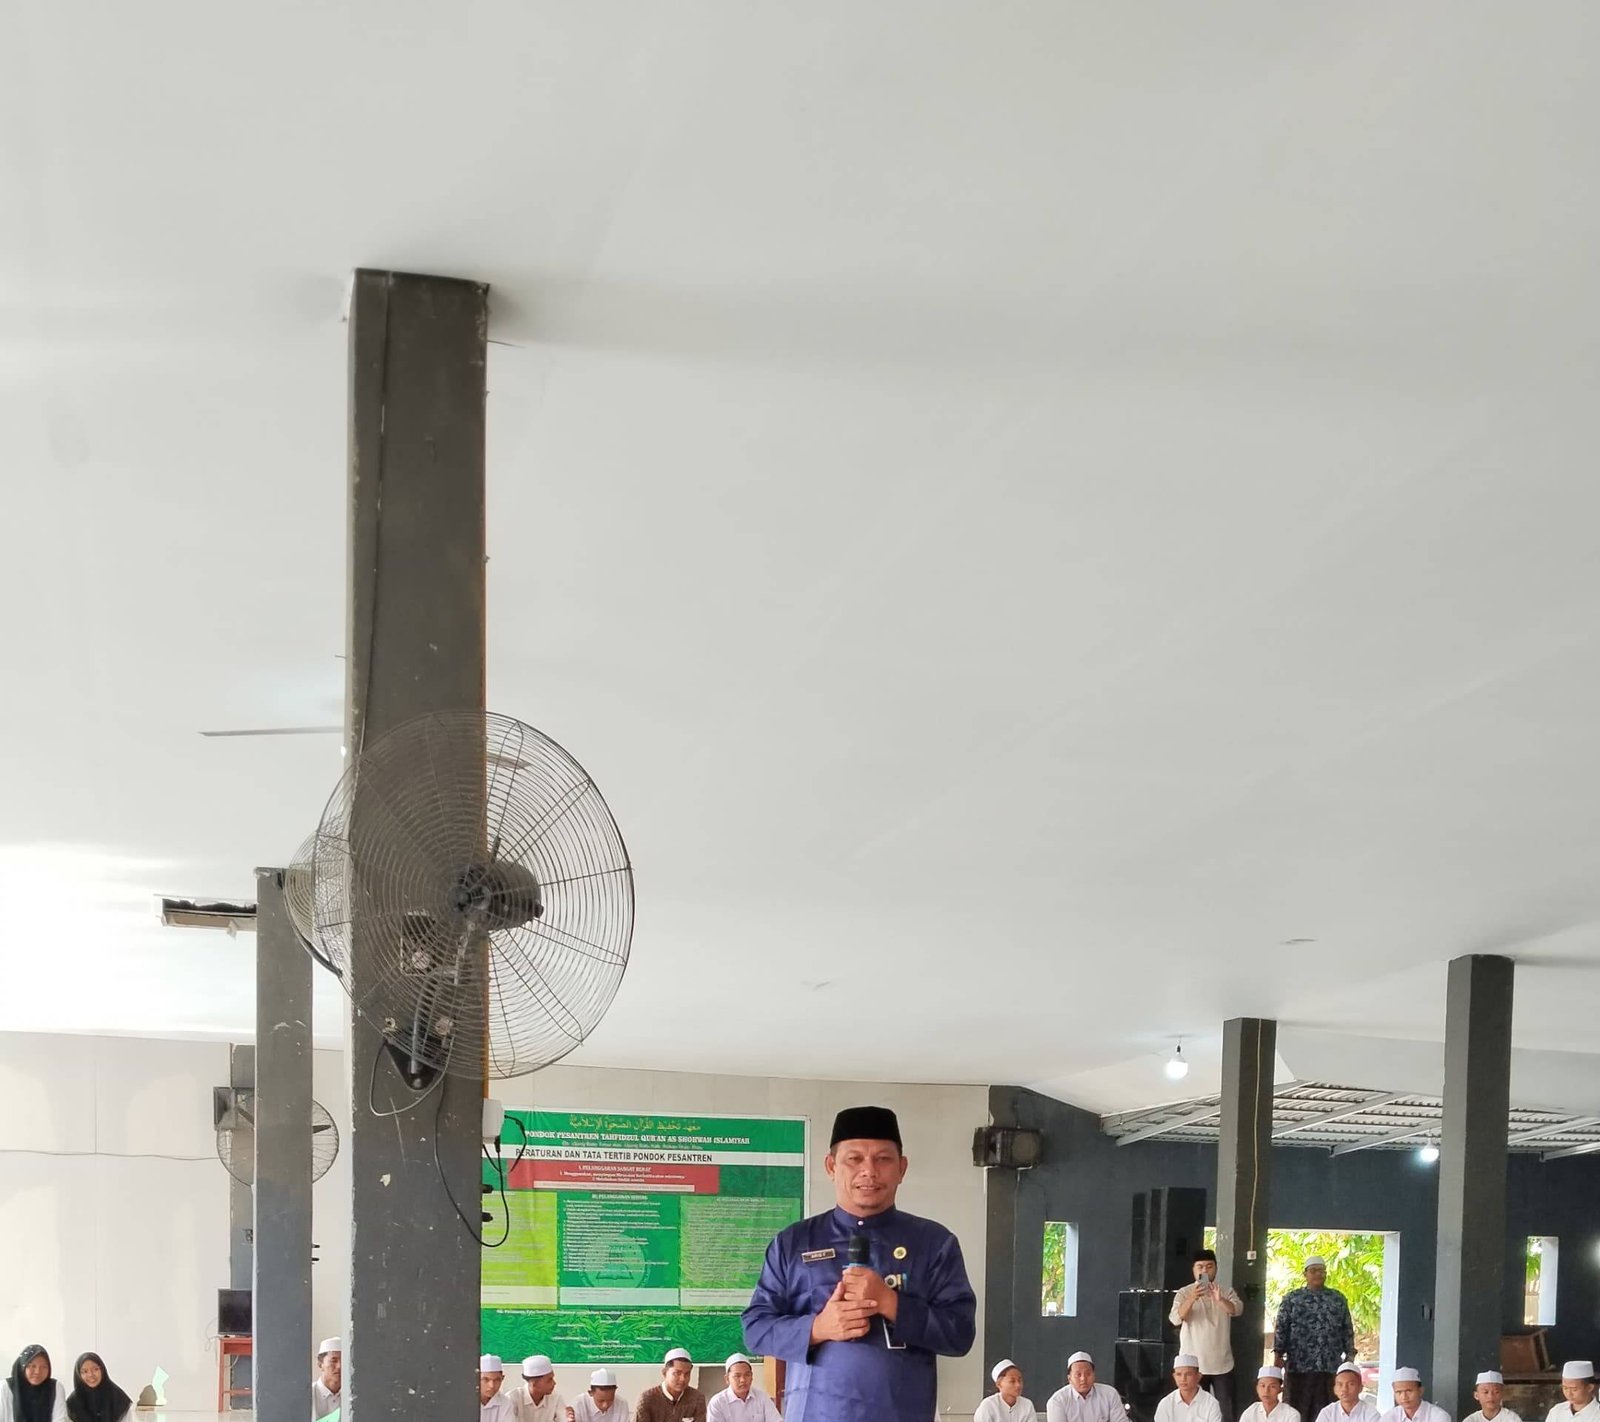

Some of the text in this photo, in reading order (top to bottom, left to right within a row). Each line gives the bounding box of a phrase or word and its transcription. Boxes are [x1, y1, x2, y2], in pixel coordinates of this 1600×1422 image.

[525, 1130, 555, 1139] PONDOK
[556, 1131, 600, 1141] PESANTREN
[600, 1133, 640, 1142] TAHFIDZUL
[667, 1135, 677, 1143] AS
[713, 1137, 750, 1145] ISLAMIYAH
[565, 1150, 581, 1159] DAN
[583, 1150, 601, 1160] TATA
[604, 1151, 631, 1161] TERTIB
[633, 1152, 666, 1162] PONDOK
[667, 1153, 713, 1163] PESANTREN
